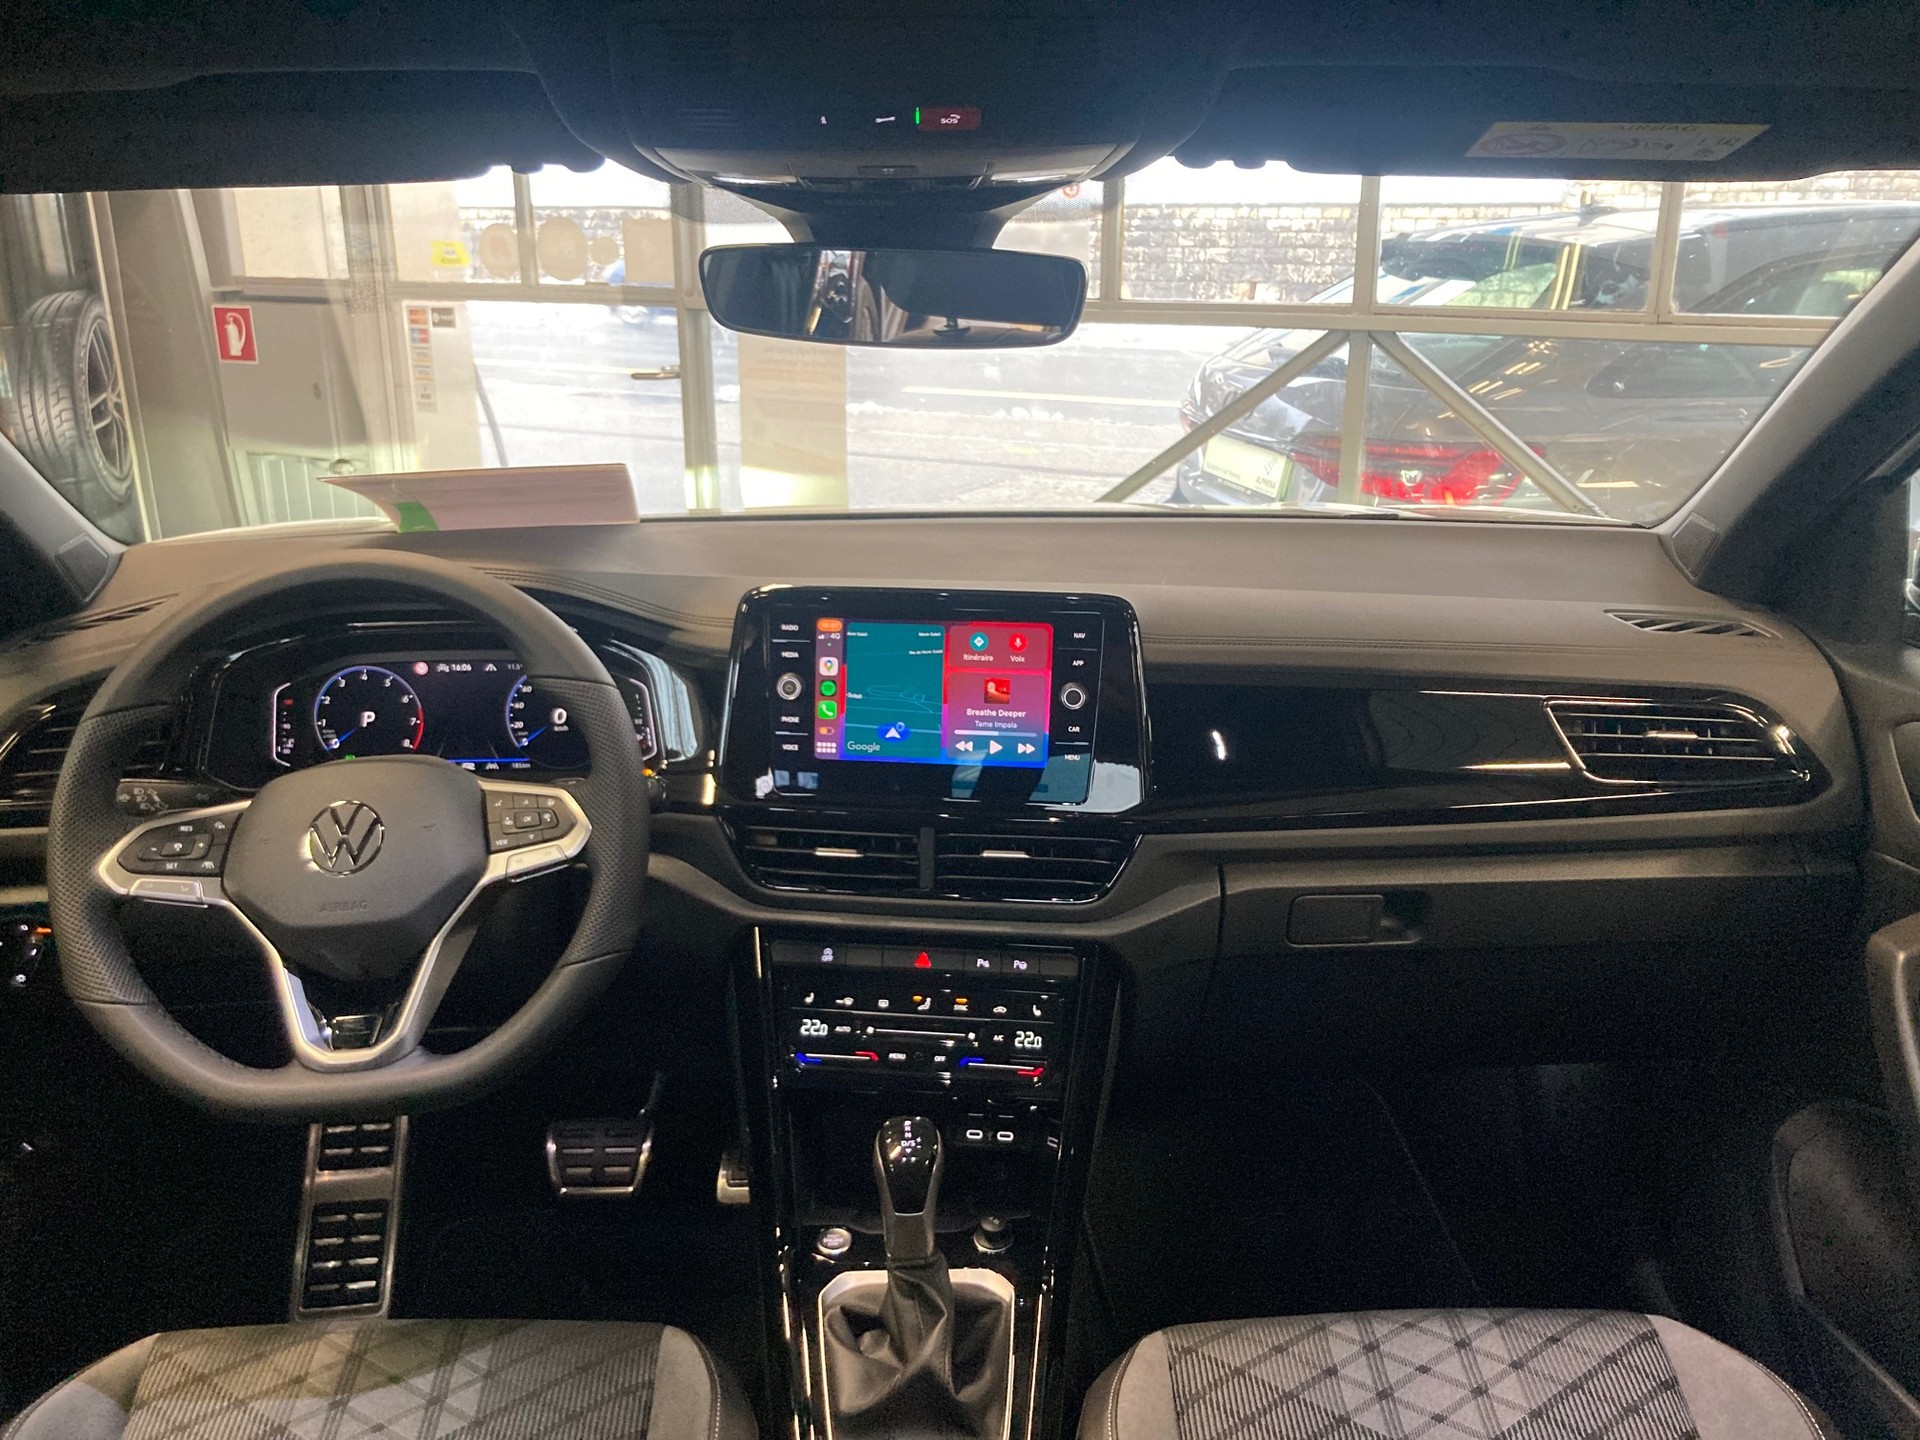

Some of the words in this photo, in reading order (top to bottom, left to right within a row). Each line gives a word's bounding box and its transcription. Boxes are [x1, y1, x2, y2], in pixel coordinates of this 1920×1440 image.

[963, 653, 994, 661] Itinéraire
[553, 707, 567, 724] 0
[966, 708, 997, 717] Breathe
[998, 709, 1026, 718] Deeper
[361, 711, 376, 727] P
[975, 720, 993, 728] Tame
[994, 721, 1018, 729] Impala
[847, 741, 880, 753] Google
[166, 862, 178, 870] SET
[319, 900, 369, 912] AIRBAG
